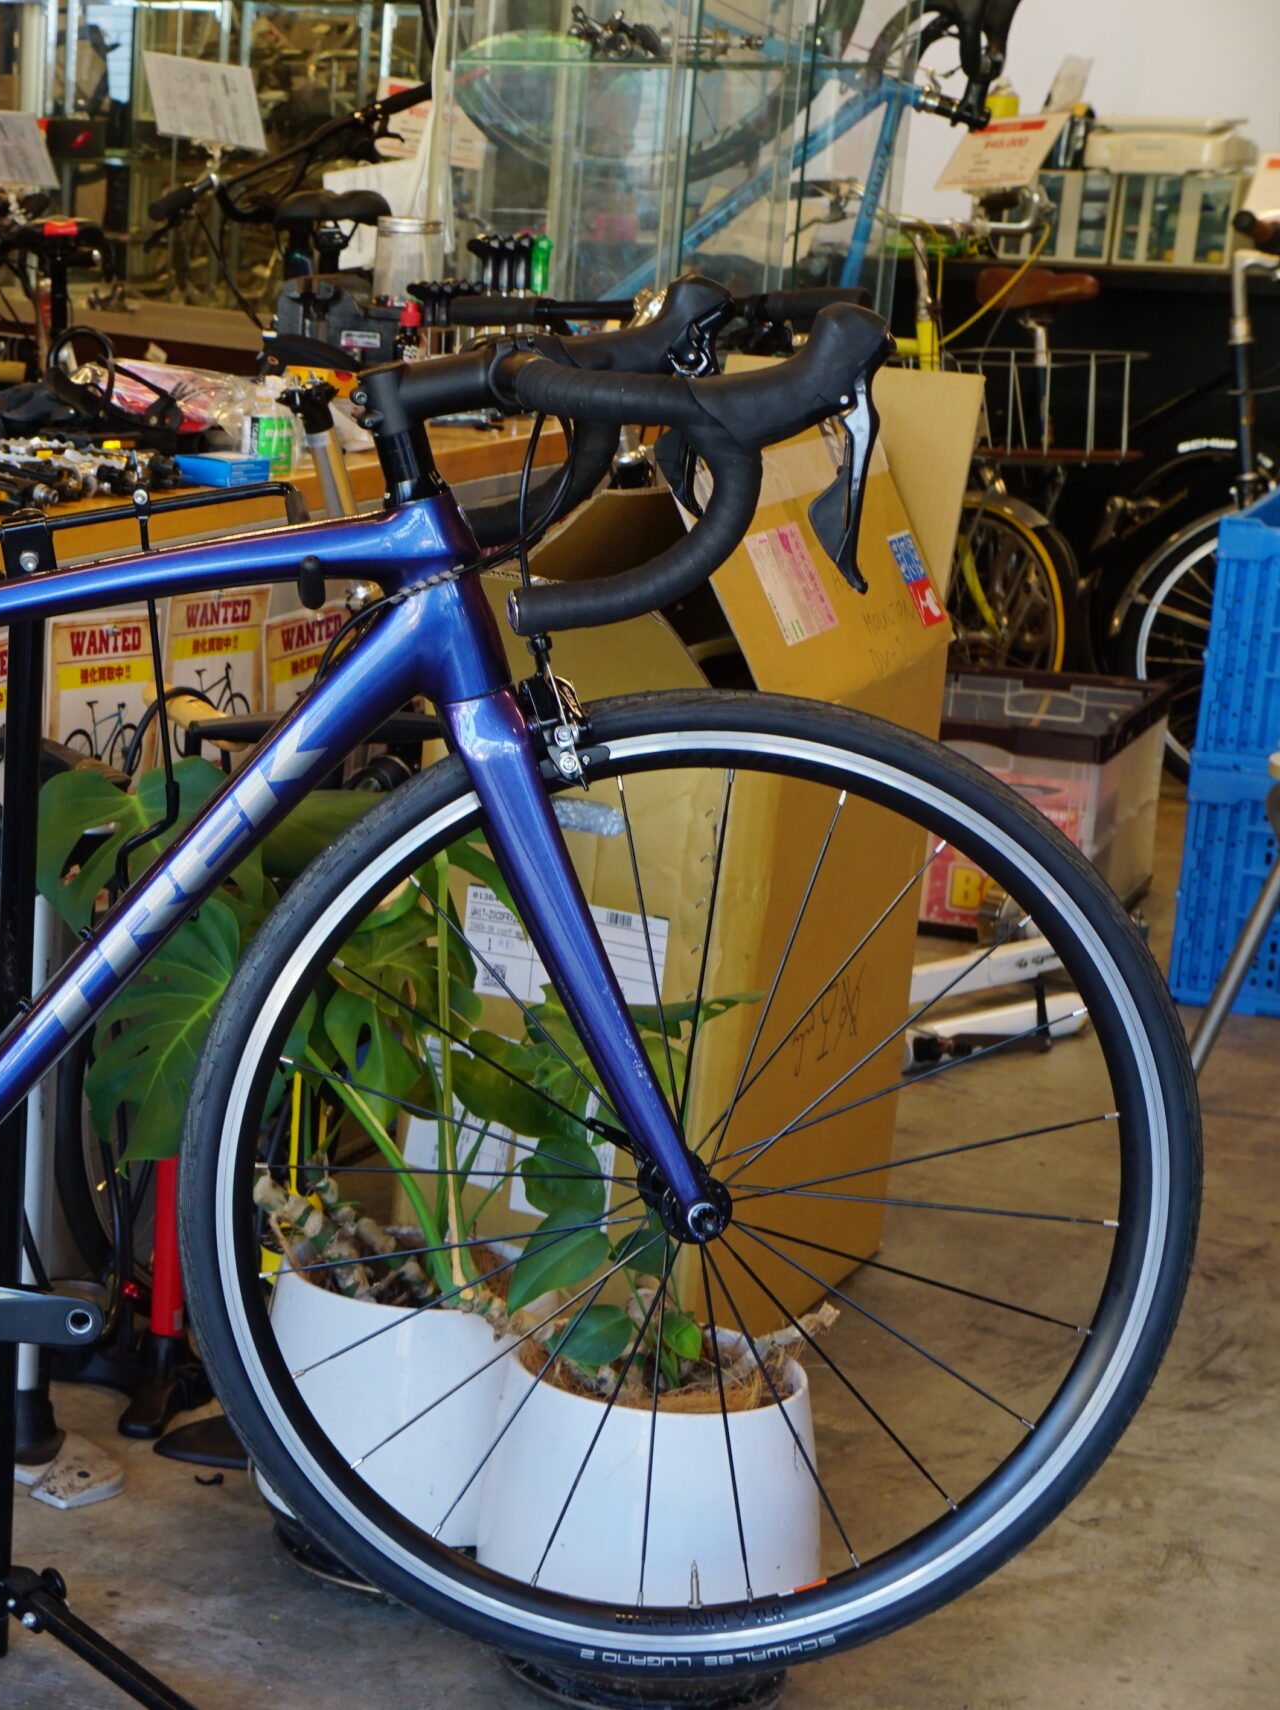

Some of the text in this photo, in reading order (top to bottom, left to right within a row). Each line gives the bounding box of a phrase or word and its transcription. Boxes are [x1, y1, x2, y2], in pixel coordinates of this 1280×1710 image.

[186, 599, 252, 629] WANTED
[70, 626, 142, 657] WANTED
[281, 614, 343, 652] WANTED
[27, 716, 328, 1036] TREK
[580, 1632, 837, 1668] SCHWALBE LUGANO 2
